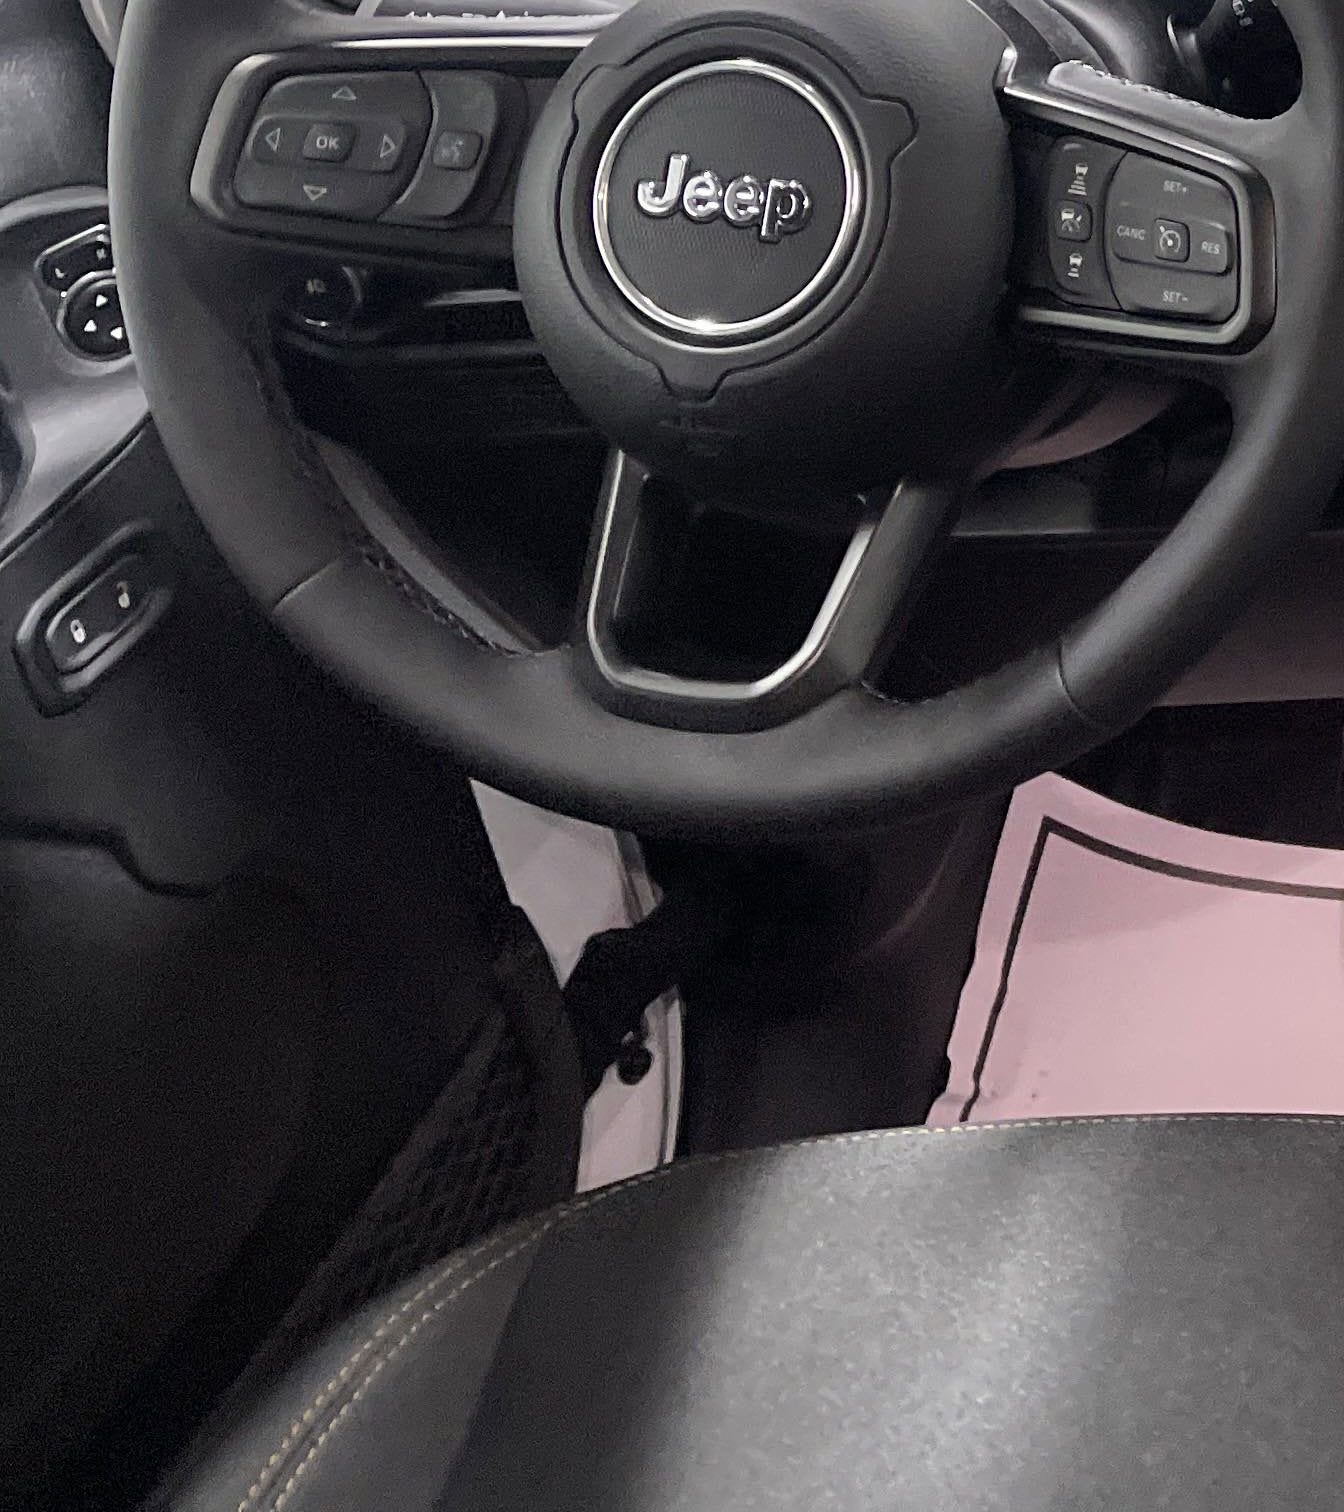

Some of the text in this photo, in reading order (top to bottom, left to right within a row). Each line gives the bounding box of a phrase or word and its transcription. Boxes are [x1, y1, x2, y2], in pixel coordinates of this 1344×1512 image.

[315, 134, 341, 151] OK
[637, 150, 811, 243] Jeep
[1116, 225, 1147, 241] CANC
[1201, 240, 1220, 255] RES
